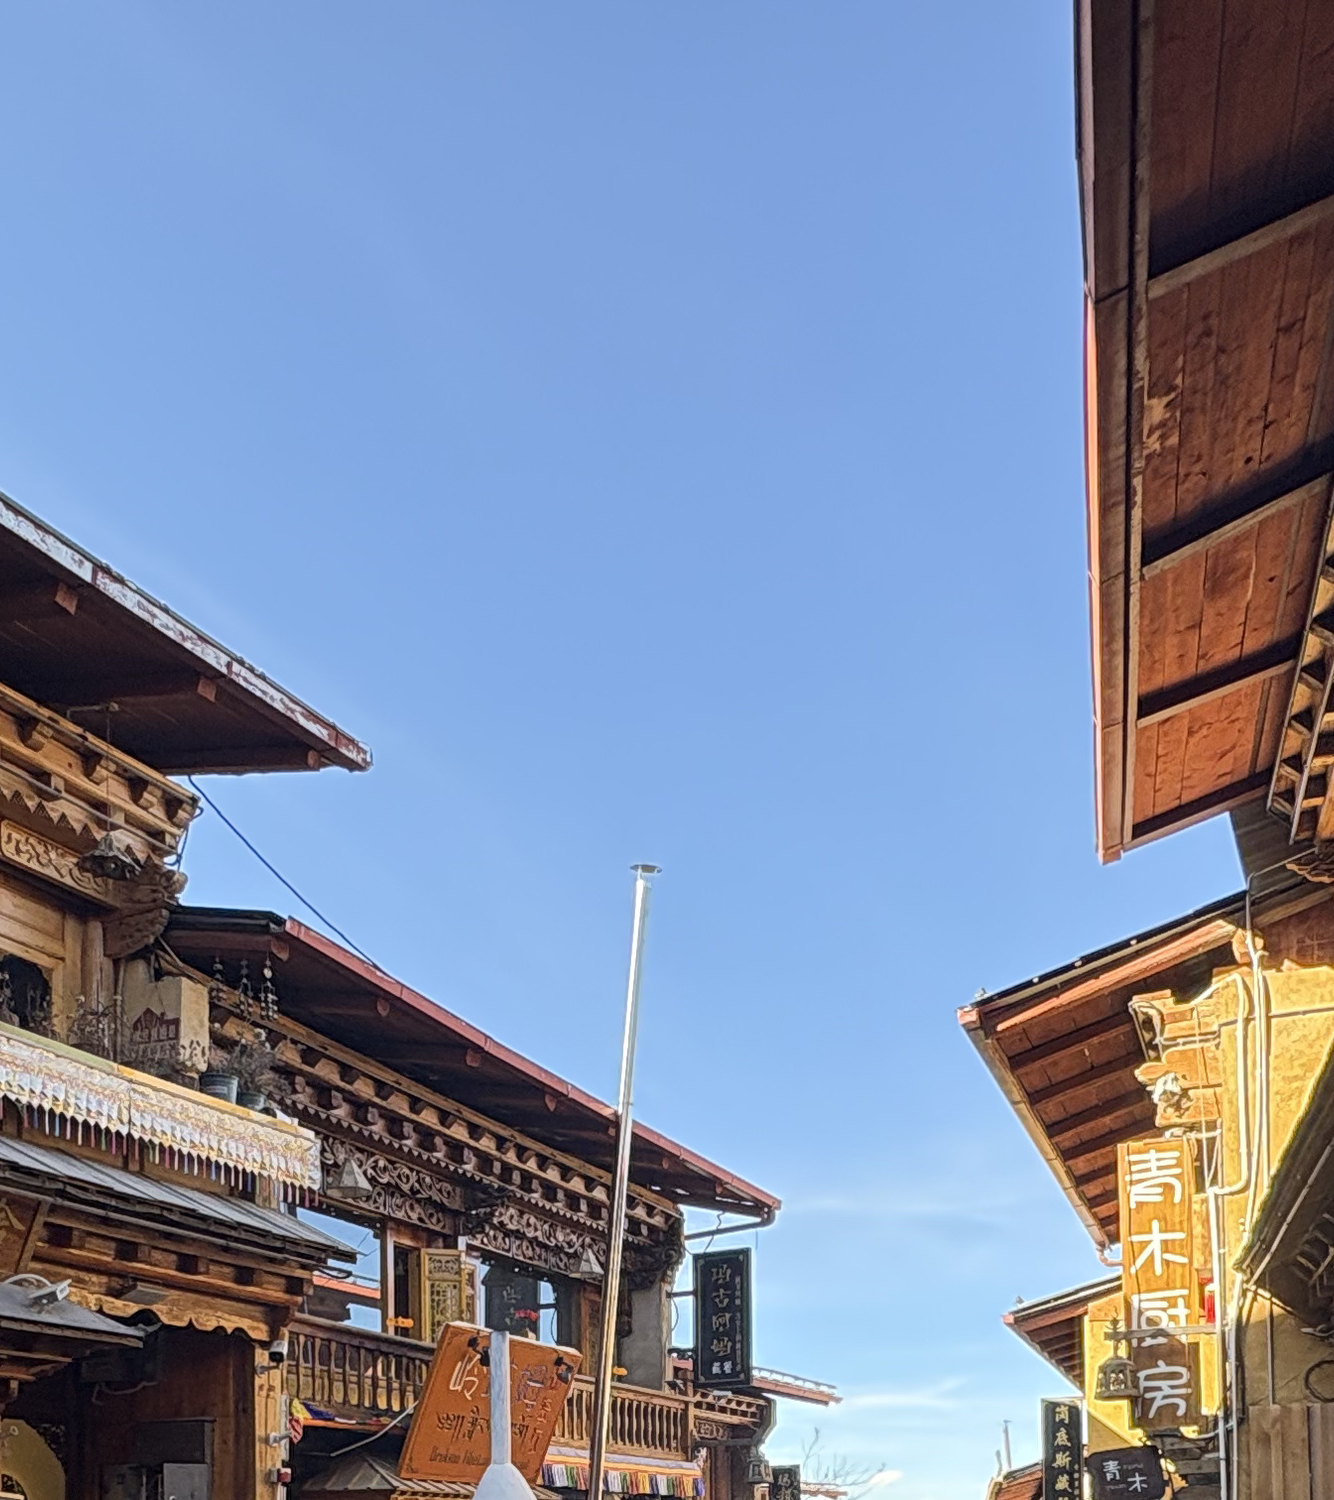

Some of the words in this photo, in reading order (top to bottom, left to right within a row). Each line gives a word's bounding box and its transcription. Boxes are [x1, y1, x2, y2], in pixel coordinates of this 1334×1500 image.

[1124, 1149, 1192, 1420] 青木厨房
[1102, 1460, 1149, 1493] 青木
